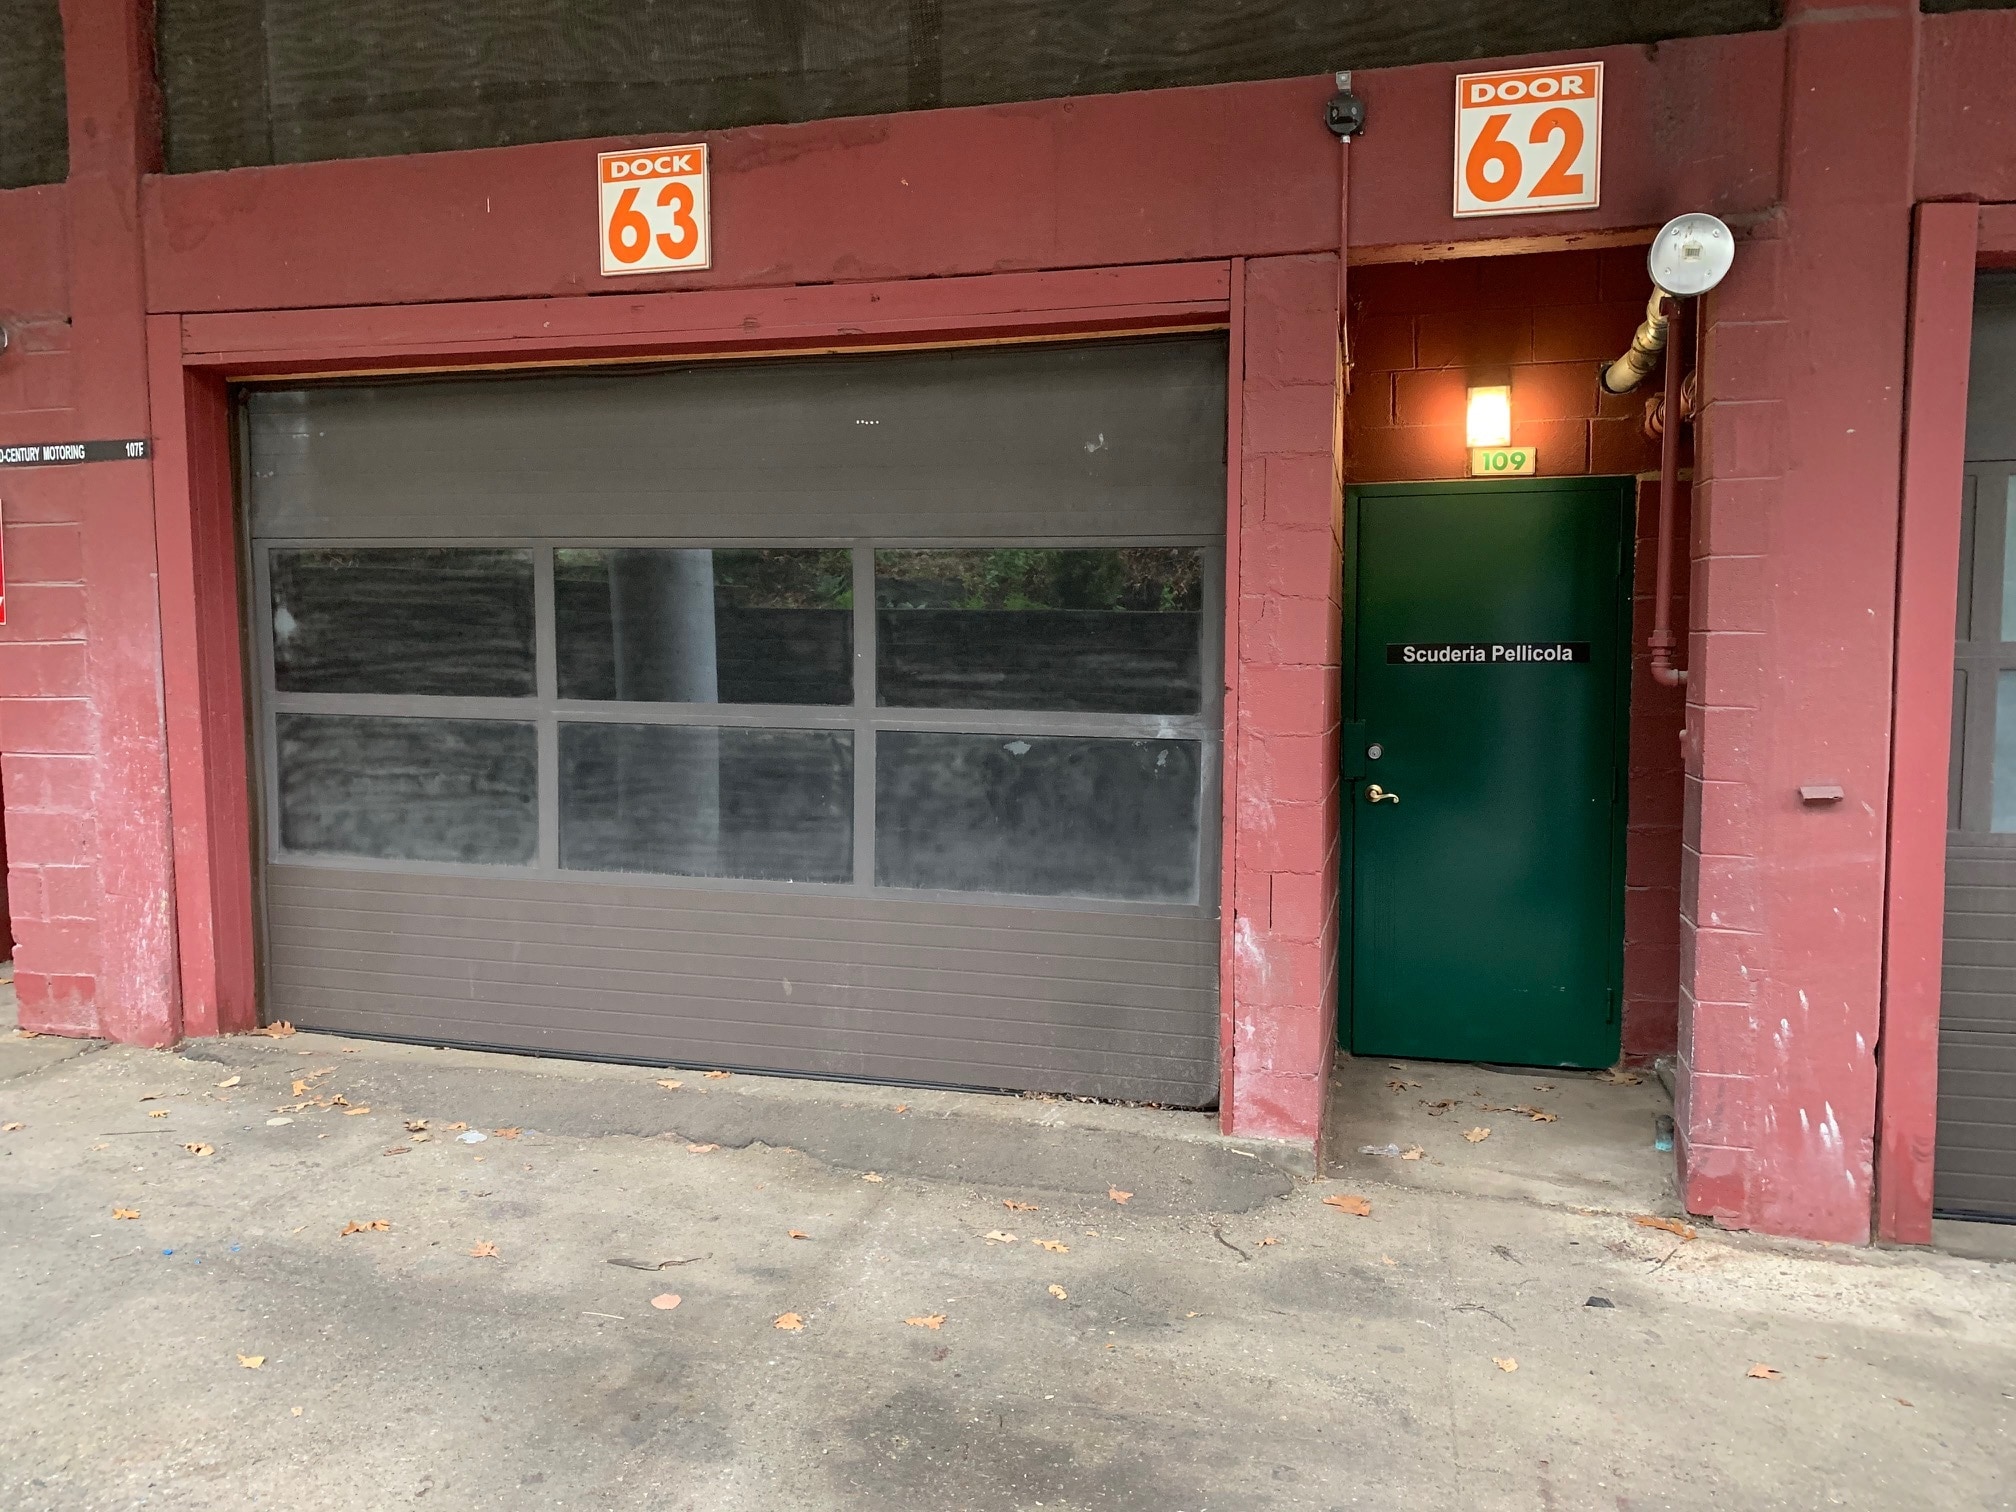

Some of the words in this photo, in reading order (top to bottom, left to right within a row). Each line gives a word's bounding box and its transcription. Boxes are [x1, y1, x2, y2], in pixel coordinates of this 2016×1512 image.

[1470, 75, 1585, 104] DOOR
[610, 154, 693, 178] DOCK
[1465, 107, 1584, 202] 62
[608, 182, 699, 264] 63
[42, 445, 86, 460] MOTORING
[1482, 451, 1527, 471] 109
[1403, 646, 1486, 662] Scuderia
[1491, 645, 1573, 662] Pellicola
